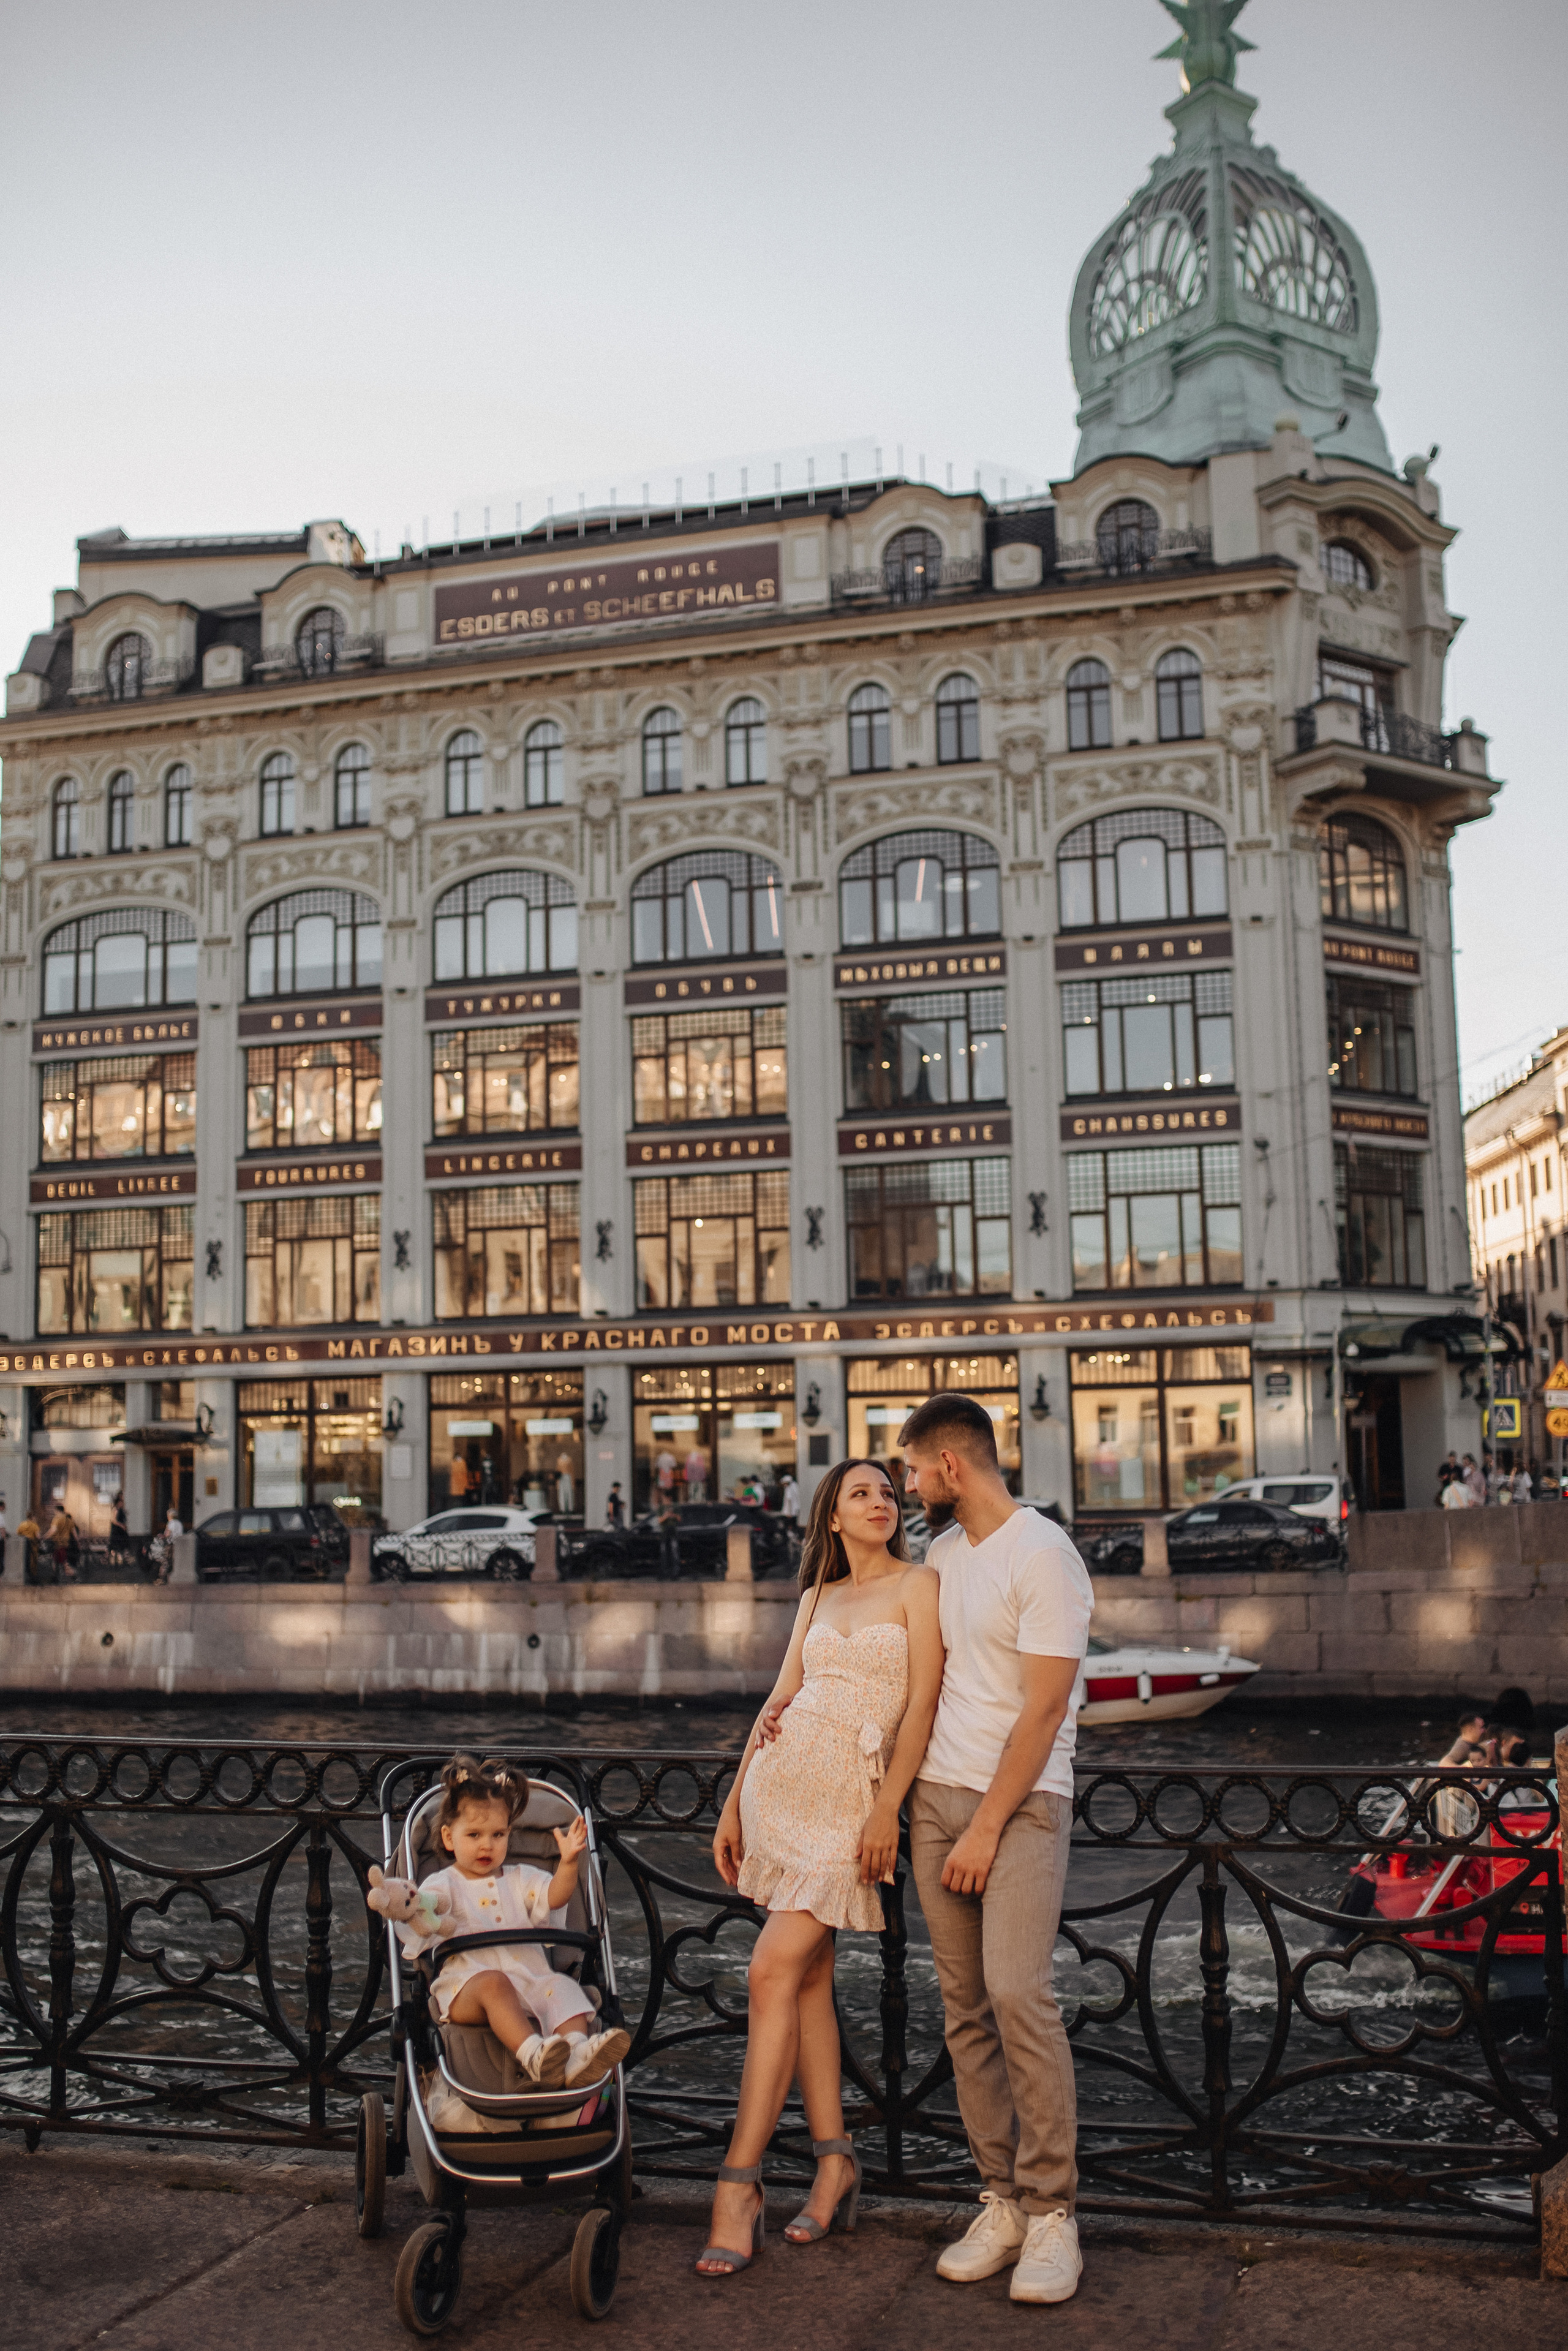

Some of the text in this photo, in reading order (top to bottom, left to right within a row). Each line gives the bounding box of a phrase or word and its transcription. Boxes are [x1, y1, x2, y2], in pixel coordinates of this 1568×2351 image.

[492, 560, 718, 602] AU PONT ROUGE
[440, 607, 549, 641] ESDERS
[583, 578, 775, 621] SCHEEFHALS
[655, 976, 756, 998] ОБУВЬ
[447, 992, 561, 1015] ТУЖУРКИ
[42, 1027, 123, 1047] МУЖСКОЕ
[1073, 1110, 1227, 1134] CHAUSSURES
[641, 1139, 775, 1161] CHAPEAUX
[444, 1152, 564, 1173] LINGERIE
[254, 1164, 366, 1185] FOURRURES
[47, 1181, 96, 1198] DEUIL
[328, 1321, 840, 1358] МАГАЗИНЪ У КРАСНАГО МОСТА
